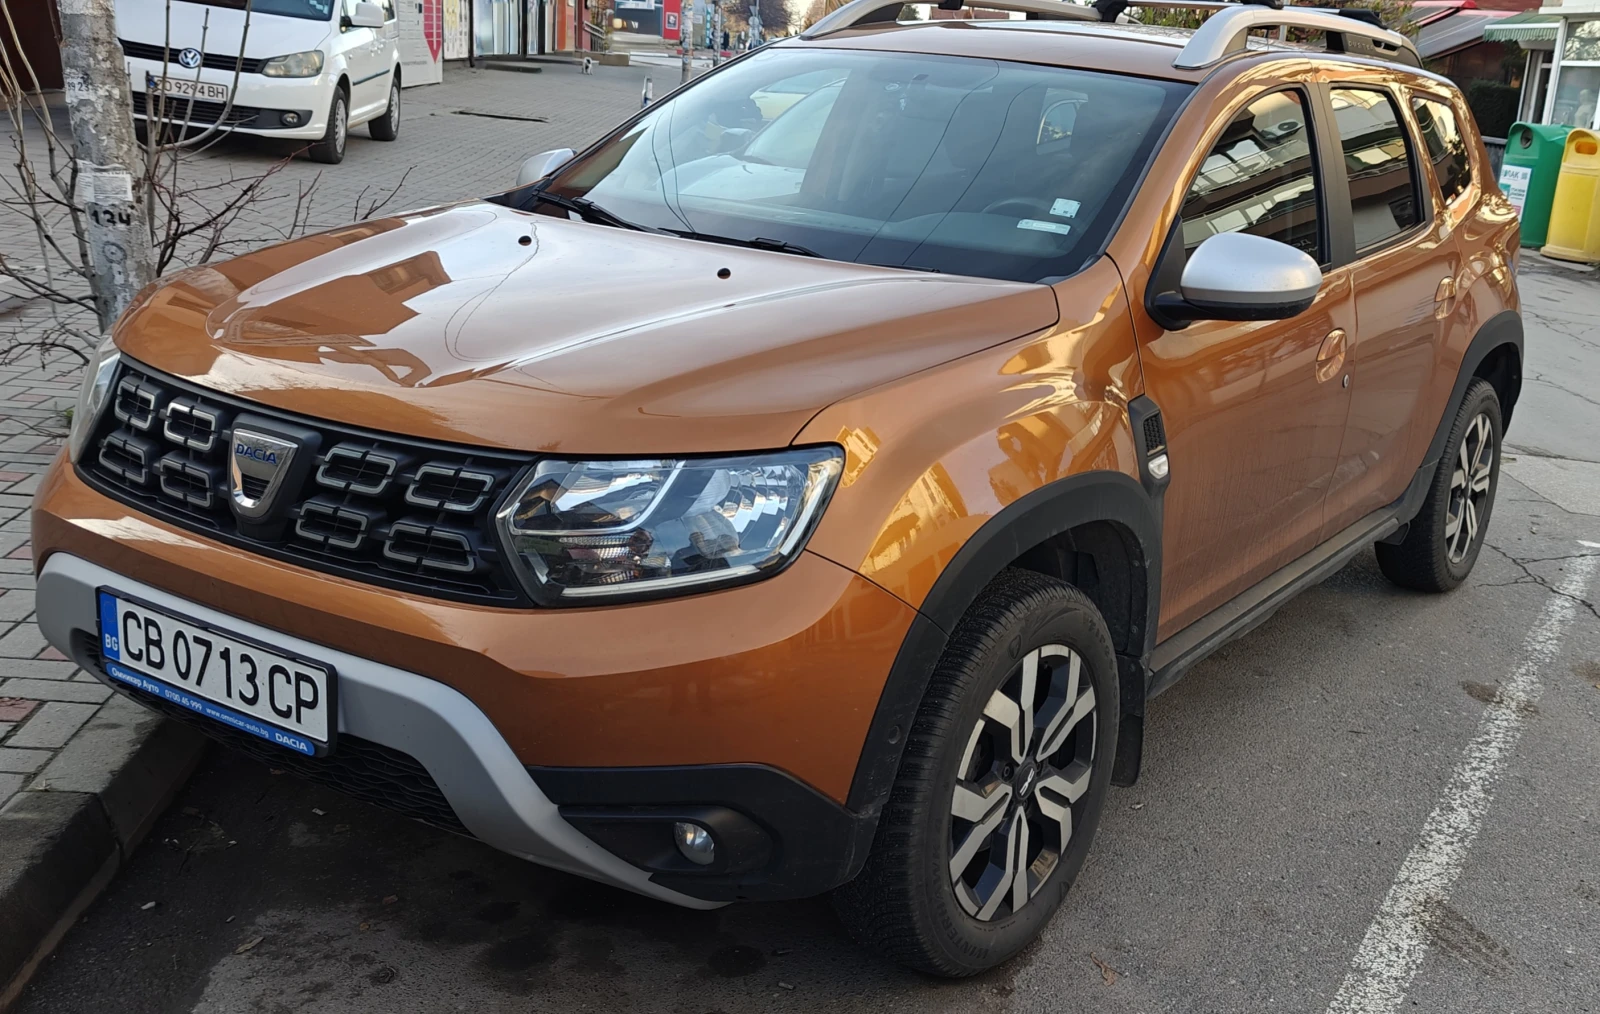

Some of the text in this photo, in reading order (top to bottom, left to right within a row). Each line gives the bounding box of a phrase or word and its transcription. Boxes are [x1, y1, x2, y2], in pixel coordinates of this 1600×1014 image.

[207, 86, 225, 99] BH
[235, 443, 277, 464] DACIA
[105, 633, 118, 651] BG
[122, 610, 319, 725] CB 0713 CP
[274, 732, 308, 752] DACIA
